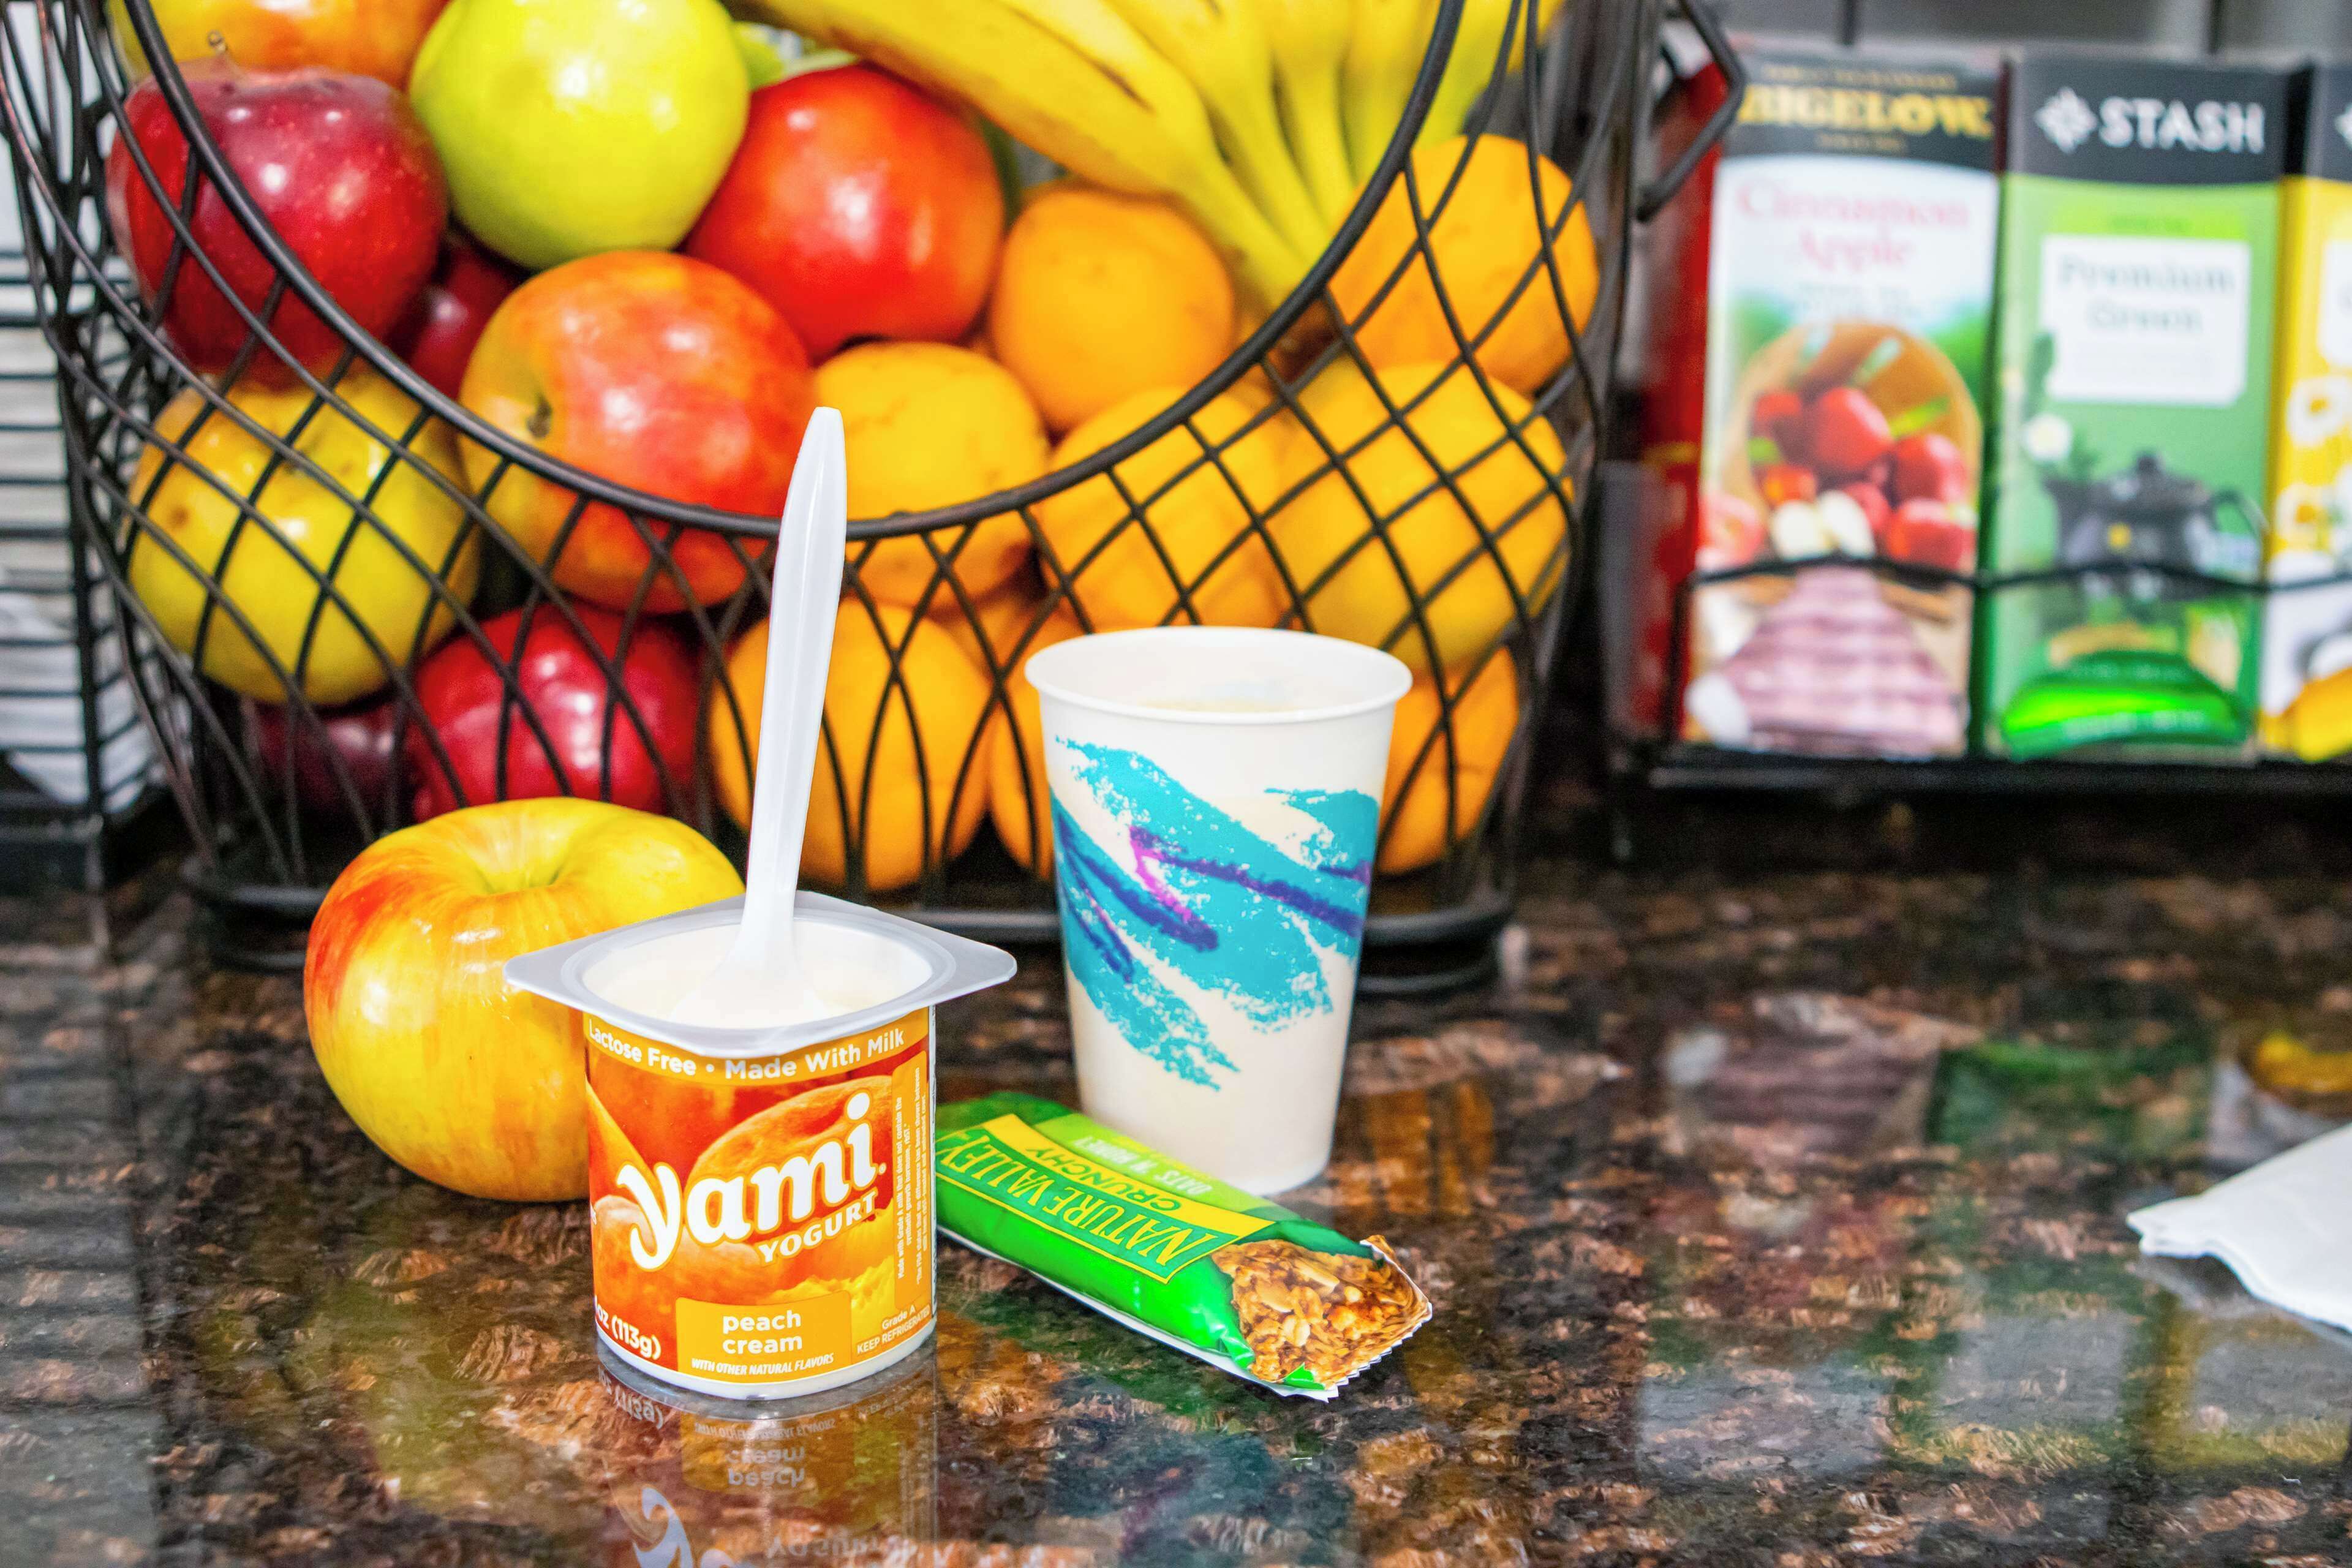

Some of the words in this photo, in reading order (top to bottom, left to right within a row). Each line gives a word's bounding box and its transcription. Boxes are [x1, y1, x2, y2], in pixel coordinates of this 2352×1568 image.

[2099, 96, 2266, 154] STASH
[1736, 180, 1970, 228] Cinnamon
[1796, 227, 1915, 273] Apple
[2059, 252, 2235, 293] Premium
[2087, 303, 2203, 334] Green
[589, 1019, 642, 1063] Lactose
[647, 1047, 696, 1076] Free
[725, 1058, 797, 1079] Made
[805, 1044, 861, 1072] With
[867, 1028, 905, 1058] Milk
[935, 1134, 1055, 1206] VALLEY
[1026, 1147, 1181, 1212] CRUNCHY
[758, 1191, 876, 1263] YOGURT
[1042, 1186, 1218, 1266] NATURE
[597, 1303, 609, 1329] oz
[611, 1314, 662, 1360] (113g)
[723, 1310, 802, 1334] peach
[882, 1311, 908, 1330] Grade
[909, 1304, 916, 1316] A
[691, 1358, 715, 1372] WITH
[716, 1362, 747, 1375] OTHER
[748, 1362, 791, 1375] NATURAL
[794, 1352, 834, 1371] FLAVORS
[722, 1335, 803, 1355] cream
[856, 1336, 880, 1354] KEEP
